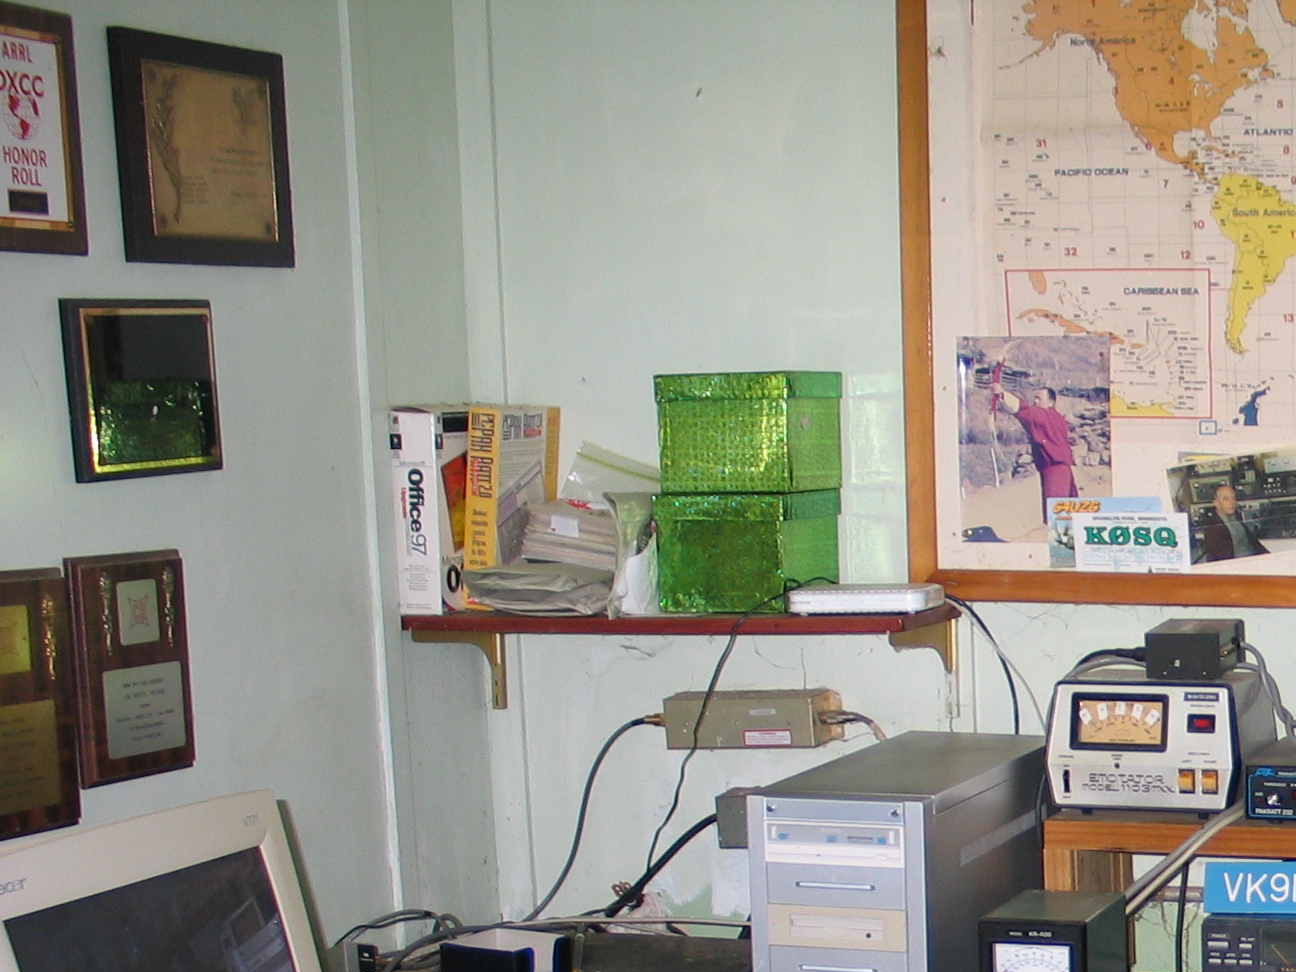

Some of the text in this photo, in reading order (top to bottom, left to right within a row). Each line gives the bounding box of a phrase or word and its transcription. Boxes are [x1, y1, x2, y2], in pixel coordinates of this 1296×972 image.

[1070, 37, 1136, 46] North America
[2, 42, 33, 64] ARRL
[1243, 128, 1294, 136] ATLANTIC
[1036, 138, 1048, 148] 31
[2, 146, 48, 168] HONOR
[12, 167, 42, 187] ROLL
[1054, 168, 1129, 177] PACIFIC OCEAN
[1232, 208, 1259, 216] South
[1192, 220, 1204, 230] 10
[1064, 248, 1078, 256] 32
[1123, 287, 1200, 296] CARIBBEAN SEA
[1283, 314, 1294, 323] 13
[408, 468, 428, 556] Office 97
